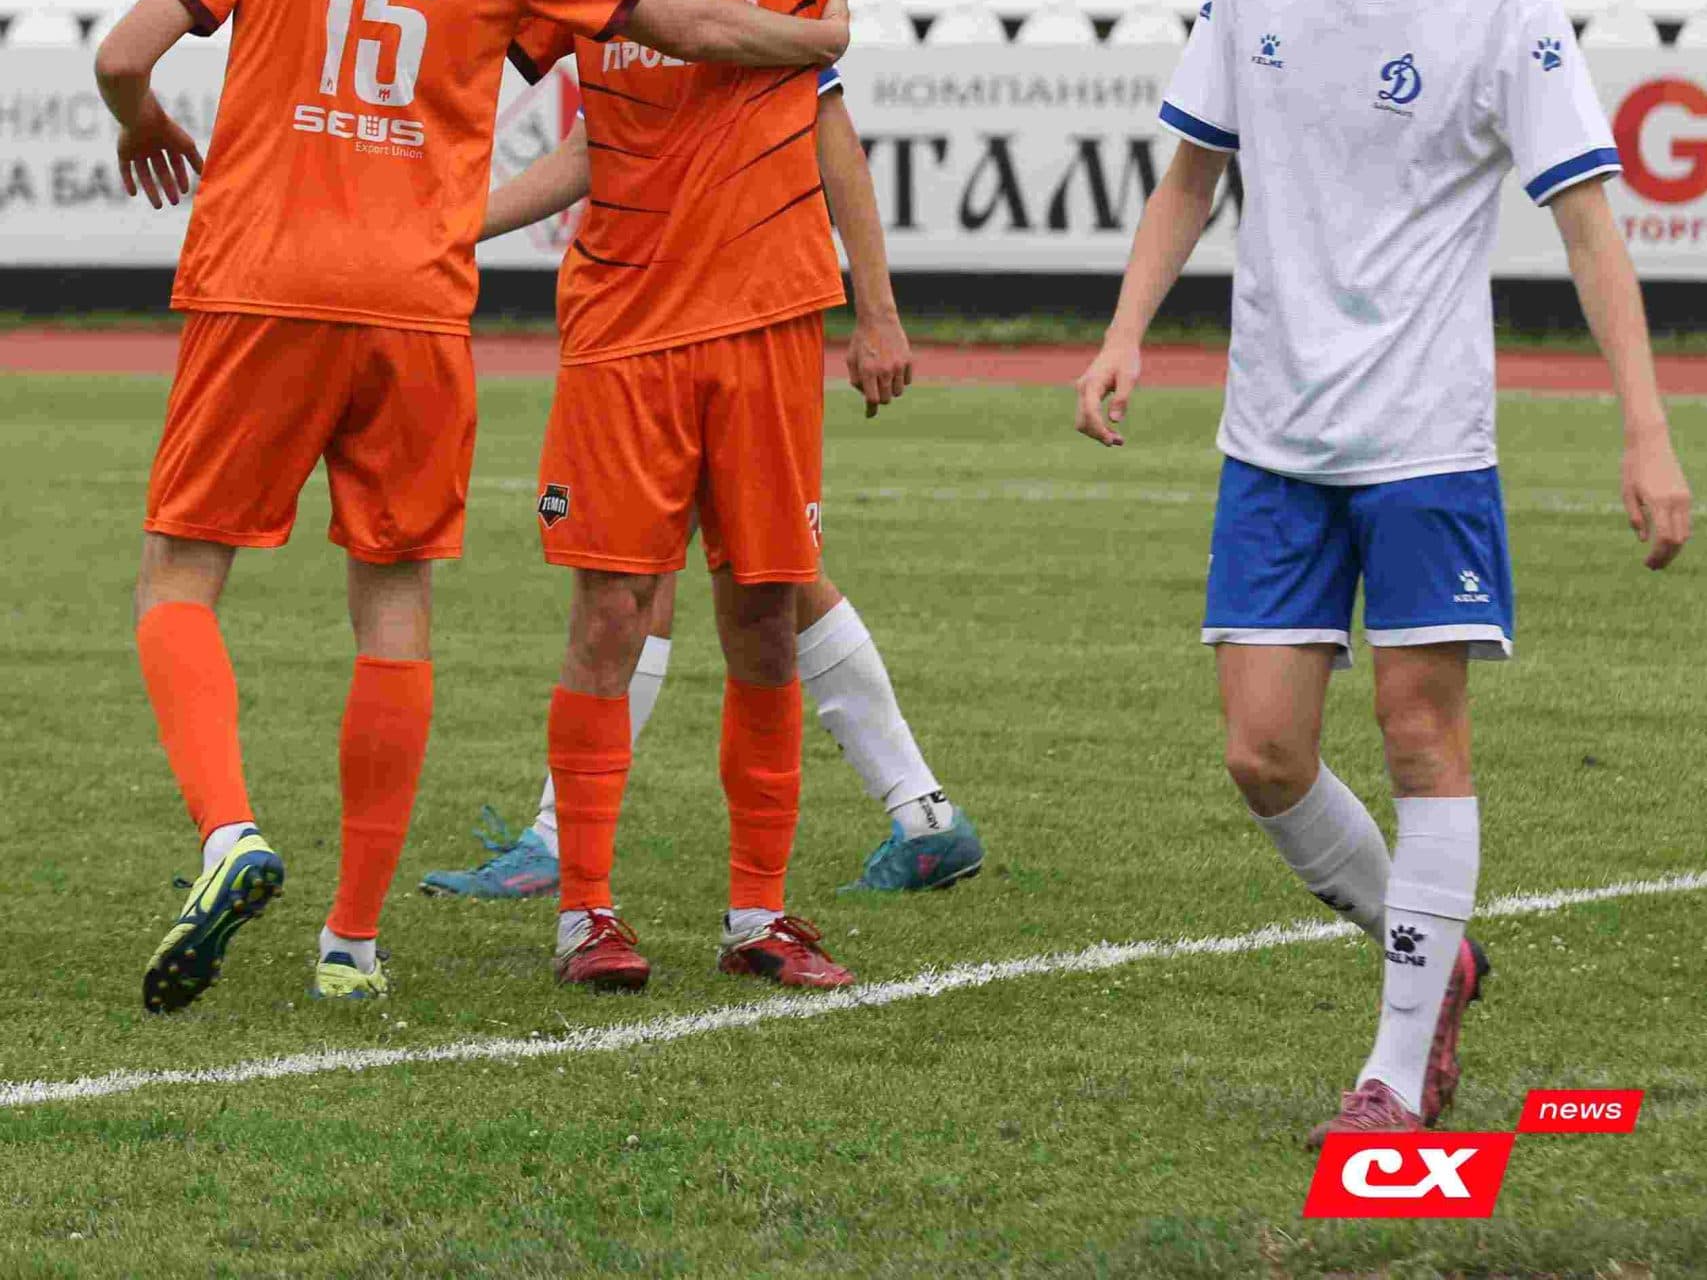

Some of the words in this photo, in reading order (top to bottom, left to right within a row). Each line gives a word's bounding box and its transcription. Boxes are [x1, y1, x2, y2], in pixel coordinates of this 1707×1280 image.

[872, 73, 1157, 107] КОМПАНИЯ
[292, 104, 425, 147] SEUS
[355, 141, 390, 155] Export
[391, 145, 425, 159] Union
[1385, 950, 1426, 967] KELME
